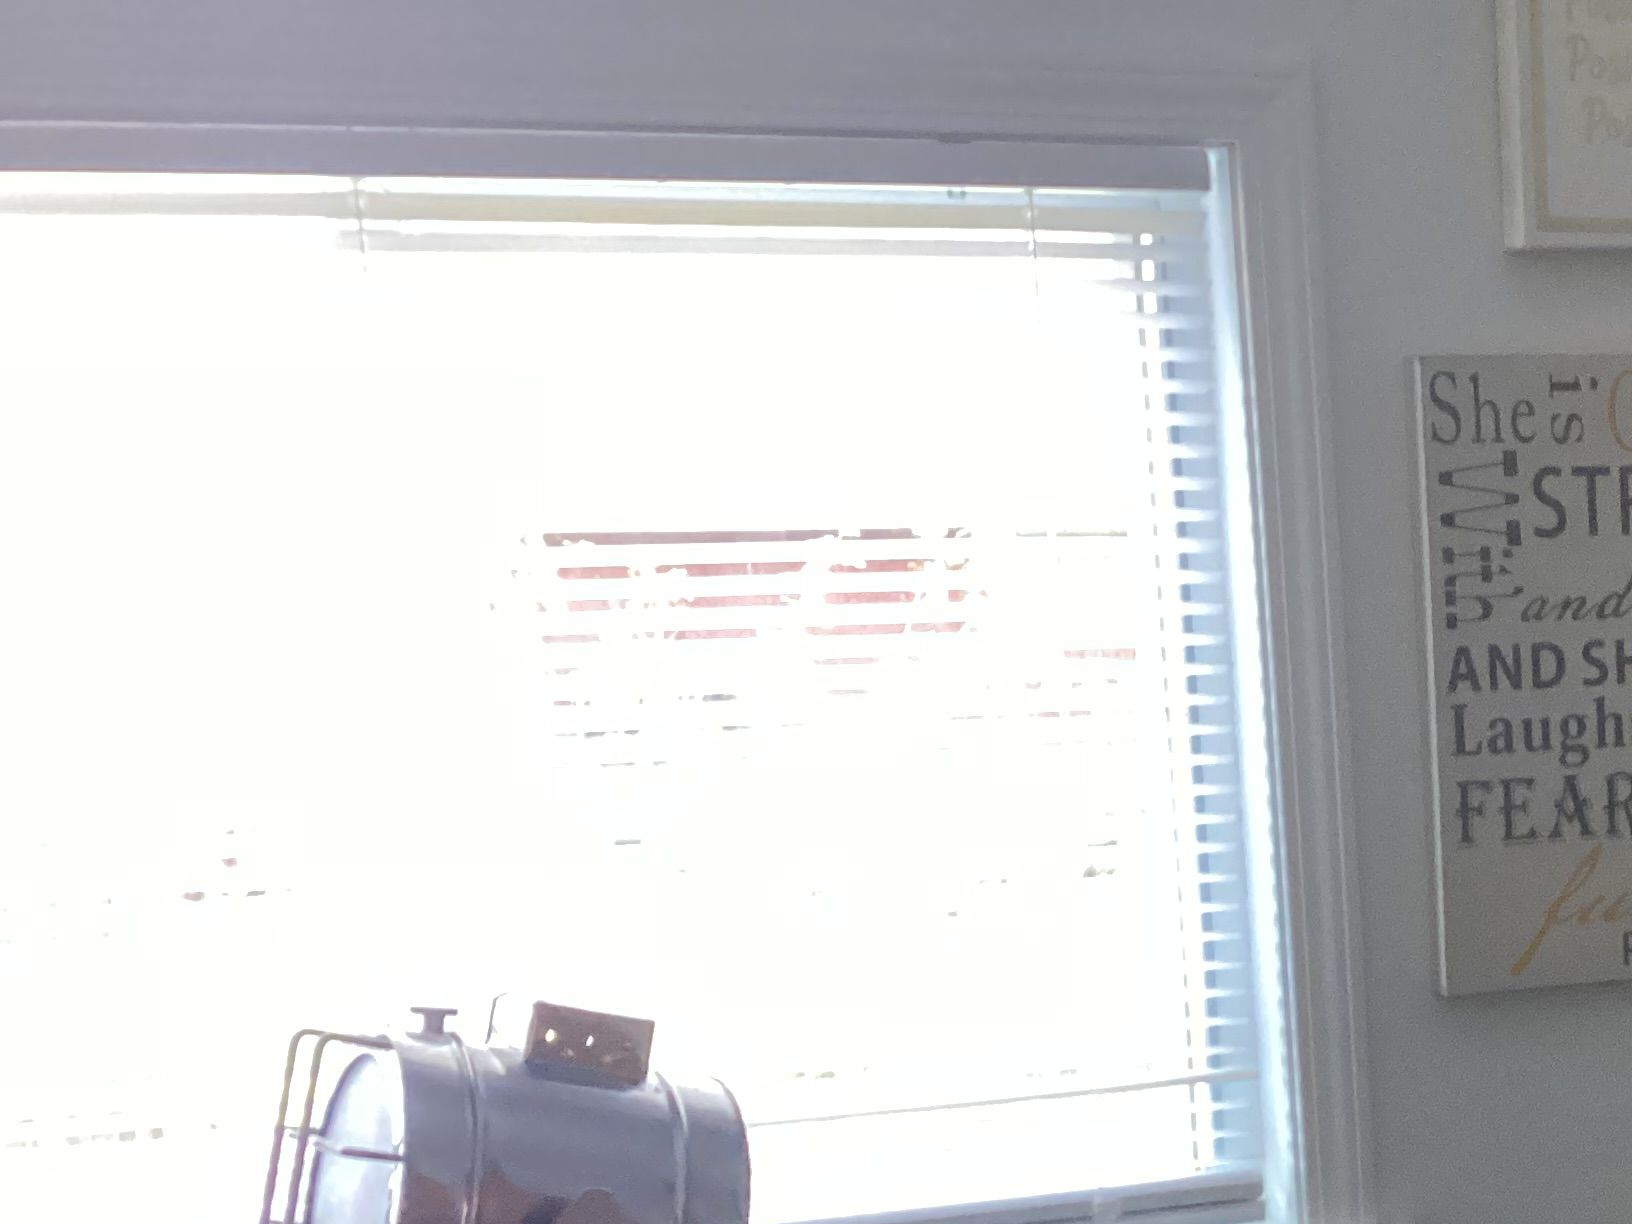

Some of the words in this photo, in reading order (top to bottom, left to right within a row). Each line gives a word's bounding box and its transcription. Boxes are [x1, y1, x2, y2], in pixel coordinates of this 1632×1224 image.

[1429, 370, 1537, 446] She
[1549, 372, 1598, 444] is
[1446, 642, 1566, 694] AND
